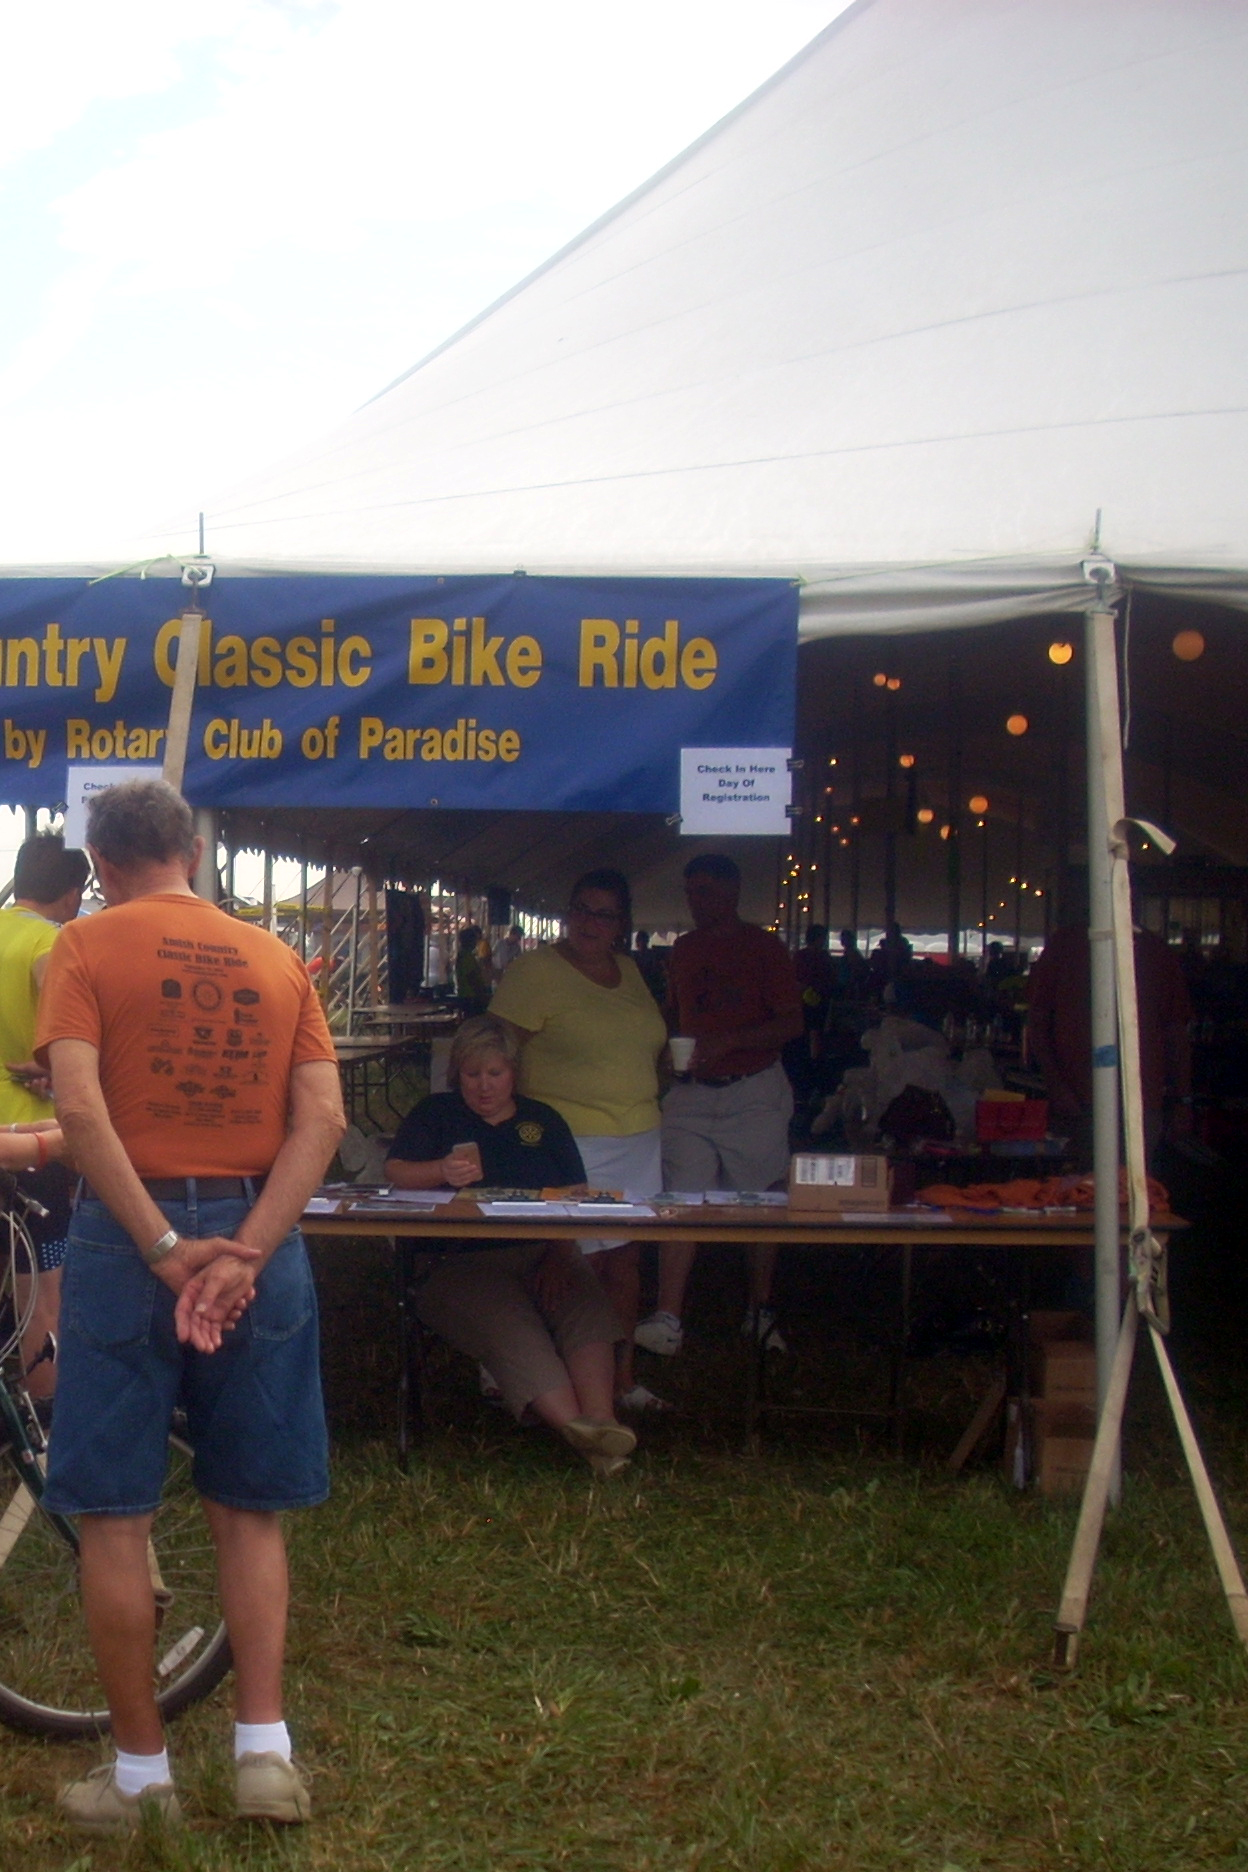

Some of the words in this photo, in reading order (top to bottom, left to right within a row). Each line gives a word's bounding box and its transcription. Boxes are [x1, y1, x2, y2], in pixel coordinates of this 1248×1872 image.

[154, 618, 372, 689] Classic
[409, 617, 543, 688] Bike
[579, 618, 718, 690] Ride
[4, 719, 46, 769] by
[67, 719, 170, 760] Rotar
[204, 718, 283, 761] Club
[302, 715, 340, 760] of
[359, 716, 521, 763] Paradise
[697, 764, 732, 774] Check
[735, 765, 746, 773] In
[750, 765, 776, 773] Here
[718, 779, 739, 789] Day
[742, 779, 755, 788] Of
[702, 793, 770, 803] Registration
